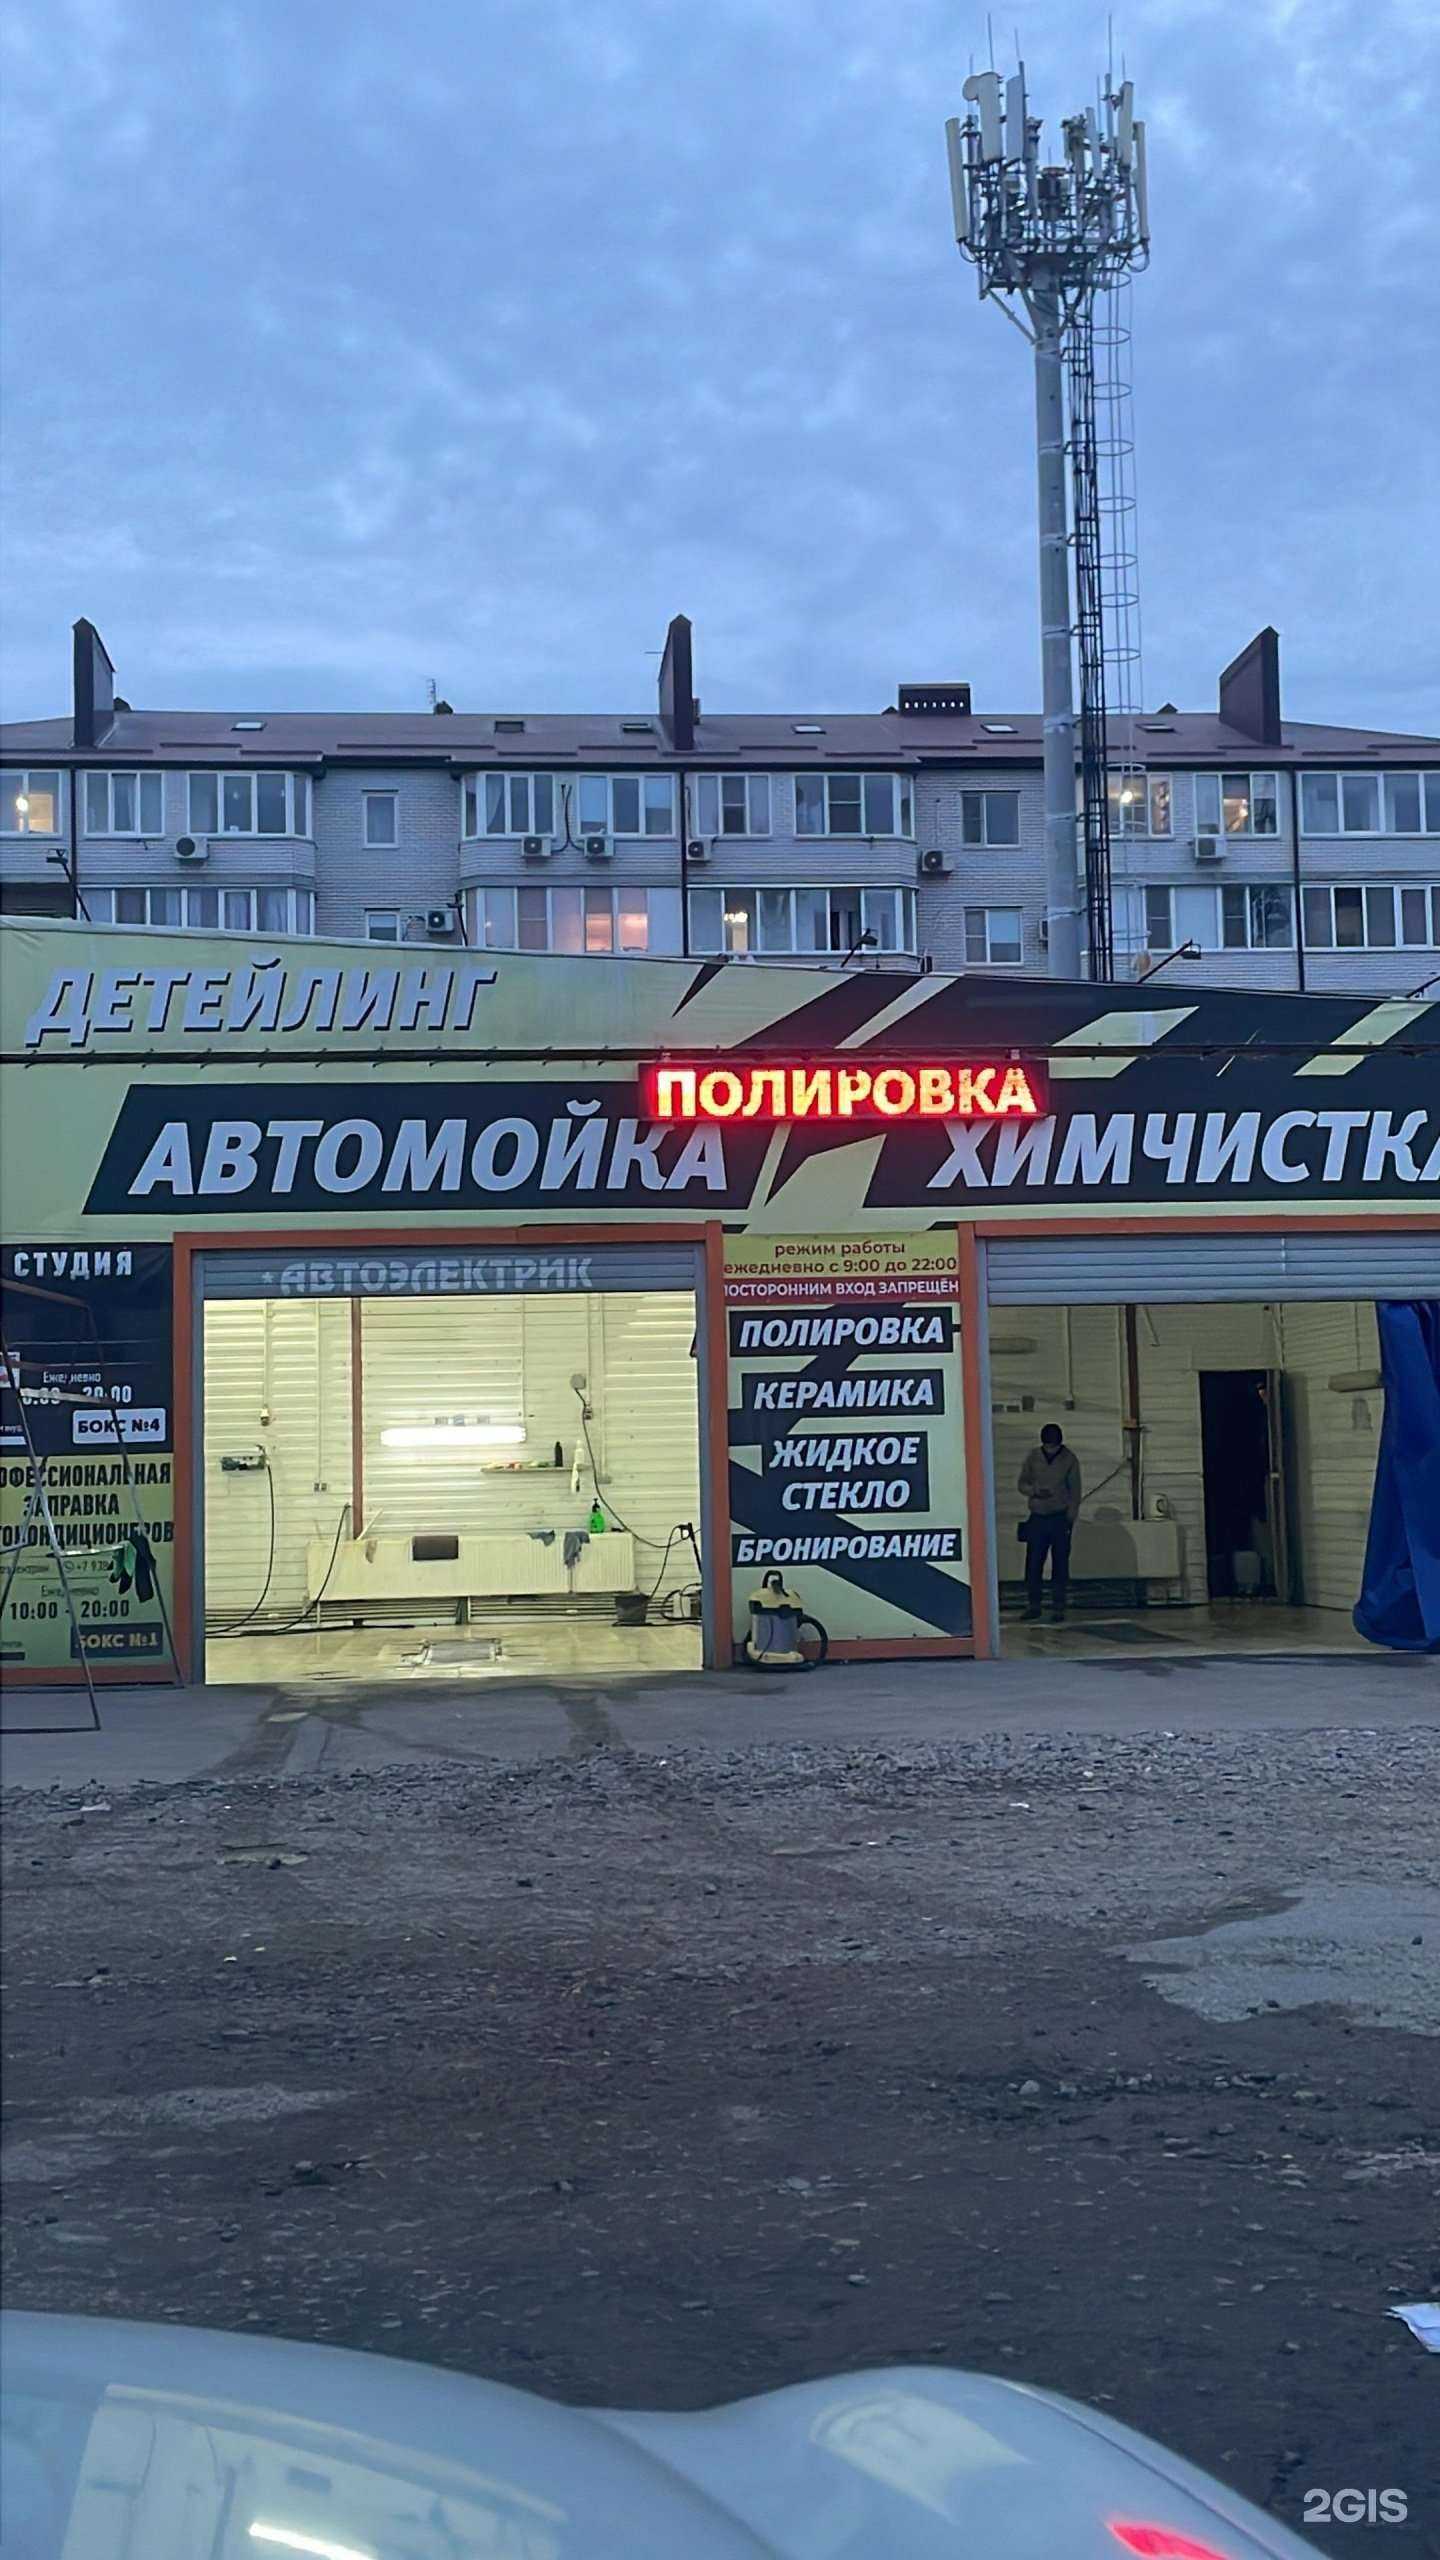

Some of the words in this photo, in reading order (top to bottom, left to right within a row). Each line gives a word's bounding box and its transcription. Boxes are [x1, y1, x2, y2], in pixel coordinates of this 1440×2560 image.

[25, 957, 498, 1048] ДЕТЕЙЛИНГ
[657, 1068, 1037, 1118] ПОЛИРОВКА
[127, 1099, 728, 1195] АВТОМОЙКА
[775, 1242, 836, 1258] режим
[841, 1241, 905, 1256] работы
[14, 1250, 133, 1281] СТУДИЯ
[280, 1257, 594, 1295] АВТОЭЛЕКТРИК
[724, 1261, 825, 1276] ежедневно
[829, 1263, 839, 1273] с
[843, 1259, 880, 1272] 9:00
[885, 1260, 907, 1274] до
[911, 1257, 956, 1271] 22:00
[836, 1280, 876, 1297] ВХОД
[879, 1277, 959, 1295] ЗАПРЕЩЁН
[739, 1316, 944, 1348] ПОЛИРОВКА
[753, 1378, 935, 1410] КЕРАМИКА
[77, 1420, 127, 1434] БОКС
[131, 1418, 160, 1433] №4
[769, 1436, 920, 1472] ЖИДКОЕ
[781, 1479, 911, 1511] СТЕКЛО
[0, 1521, 175, 1549] ОКОНДИЦИОНЕОВ
[737, 1533, 956, 1562] БРОНИРОВАНИЕ
[10, 1602, 58, 1620] 10:00
[80, 1600, 130, 1617] 20:00
